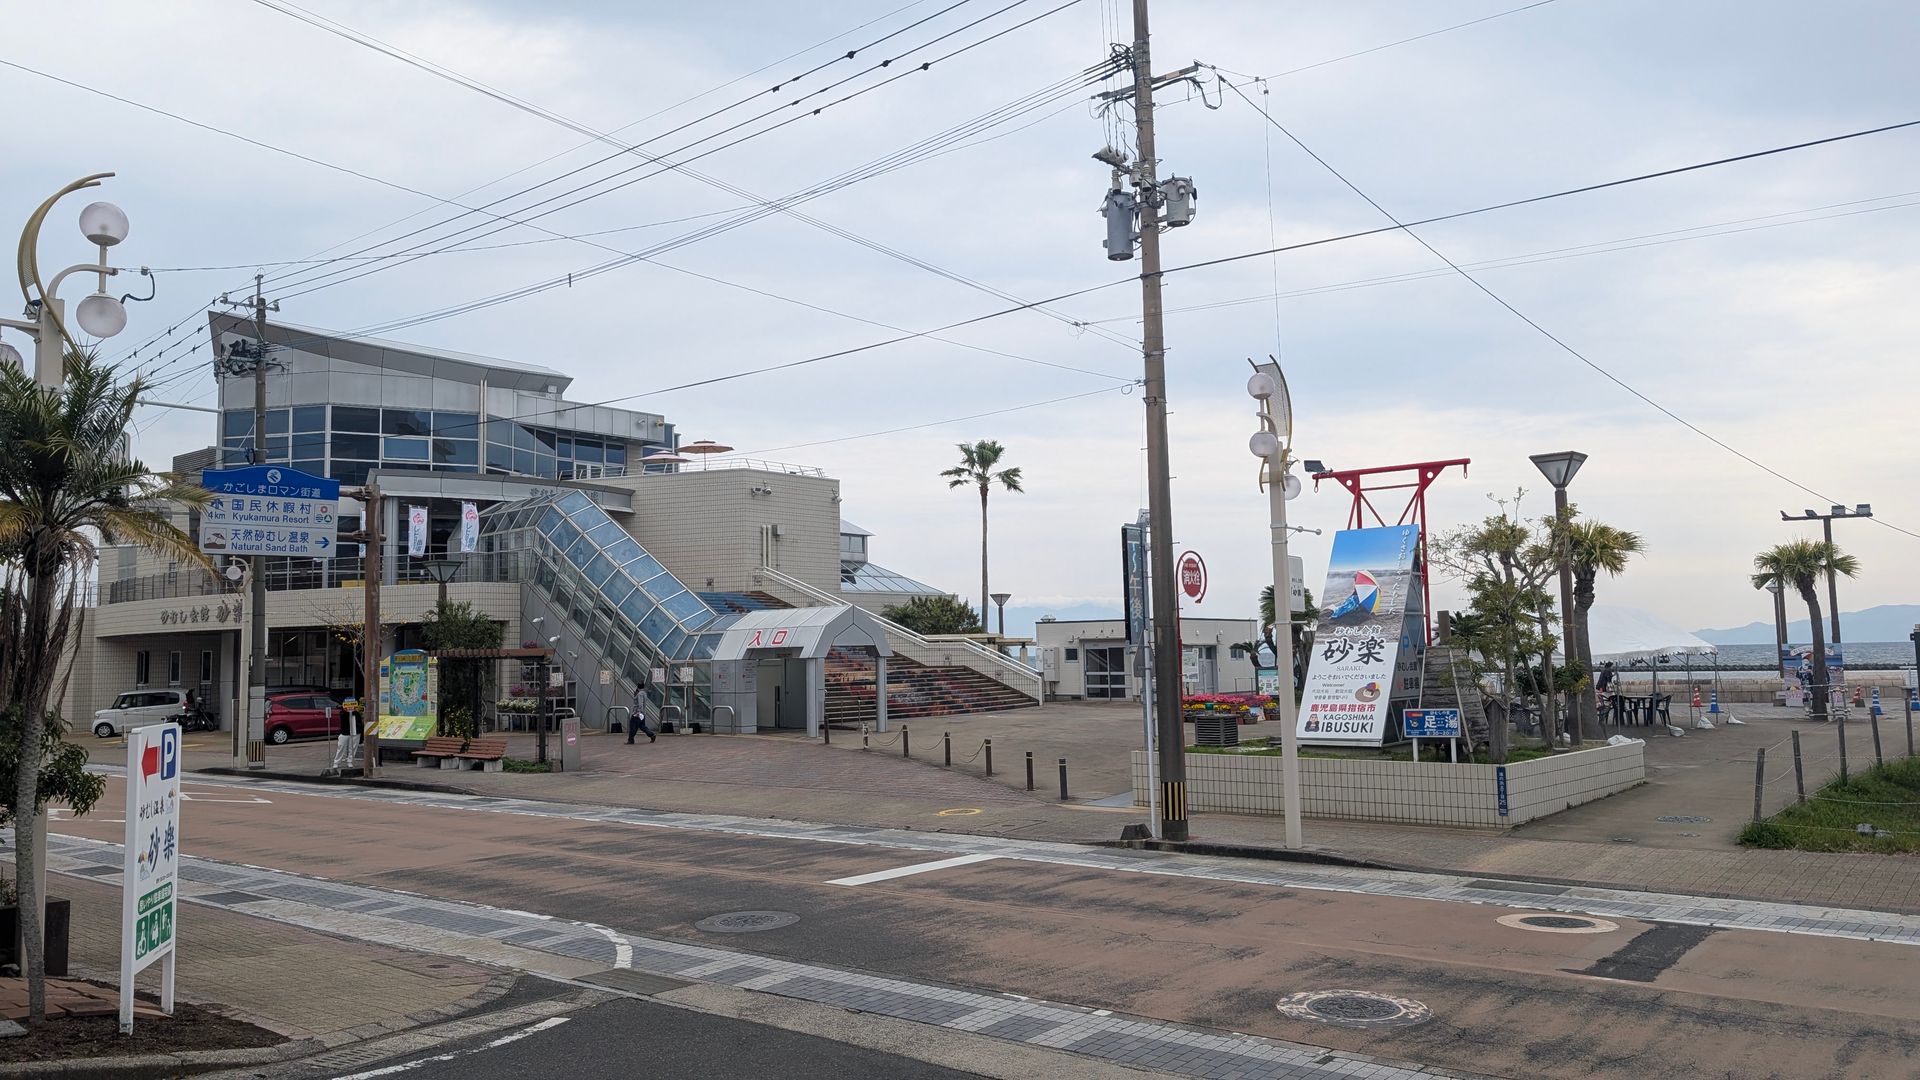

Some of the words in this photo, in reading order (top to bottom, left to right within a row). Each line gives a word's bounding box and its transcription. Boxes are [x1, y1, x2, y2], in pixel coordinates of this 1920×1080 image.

[223, 482, 321, 498] かごしまロマン街道
[231, 499, 312, 515] 国民休暇村
[232, 512, 280, 523] Kyukamura
[282, 514, 309, 524] Resort
[231, 529, 310, 544] 天然砂むし温泉
[231, 542, 262, 551] Natural
[265, 544, 287, 552] Sand
[289, 544, 308, 553] Bath
[1183, 570, 1200, 585] 消火栓
[748, 629, 789, 648] 入口
[1334, 625, 1382, 637] 砂むし会館
[1321, 636, 1385, 666] 砂楽
[1310, 704, 1376, 712] 鹿児島県指宿市
[1321, 722, 1374, 733] IBUSUKI
[163, 733, 174, 777] P
[148, 820, 175, 873] 砂楽
